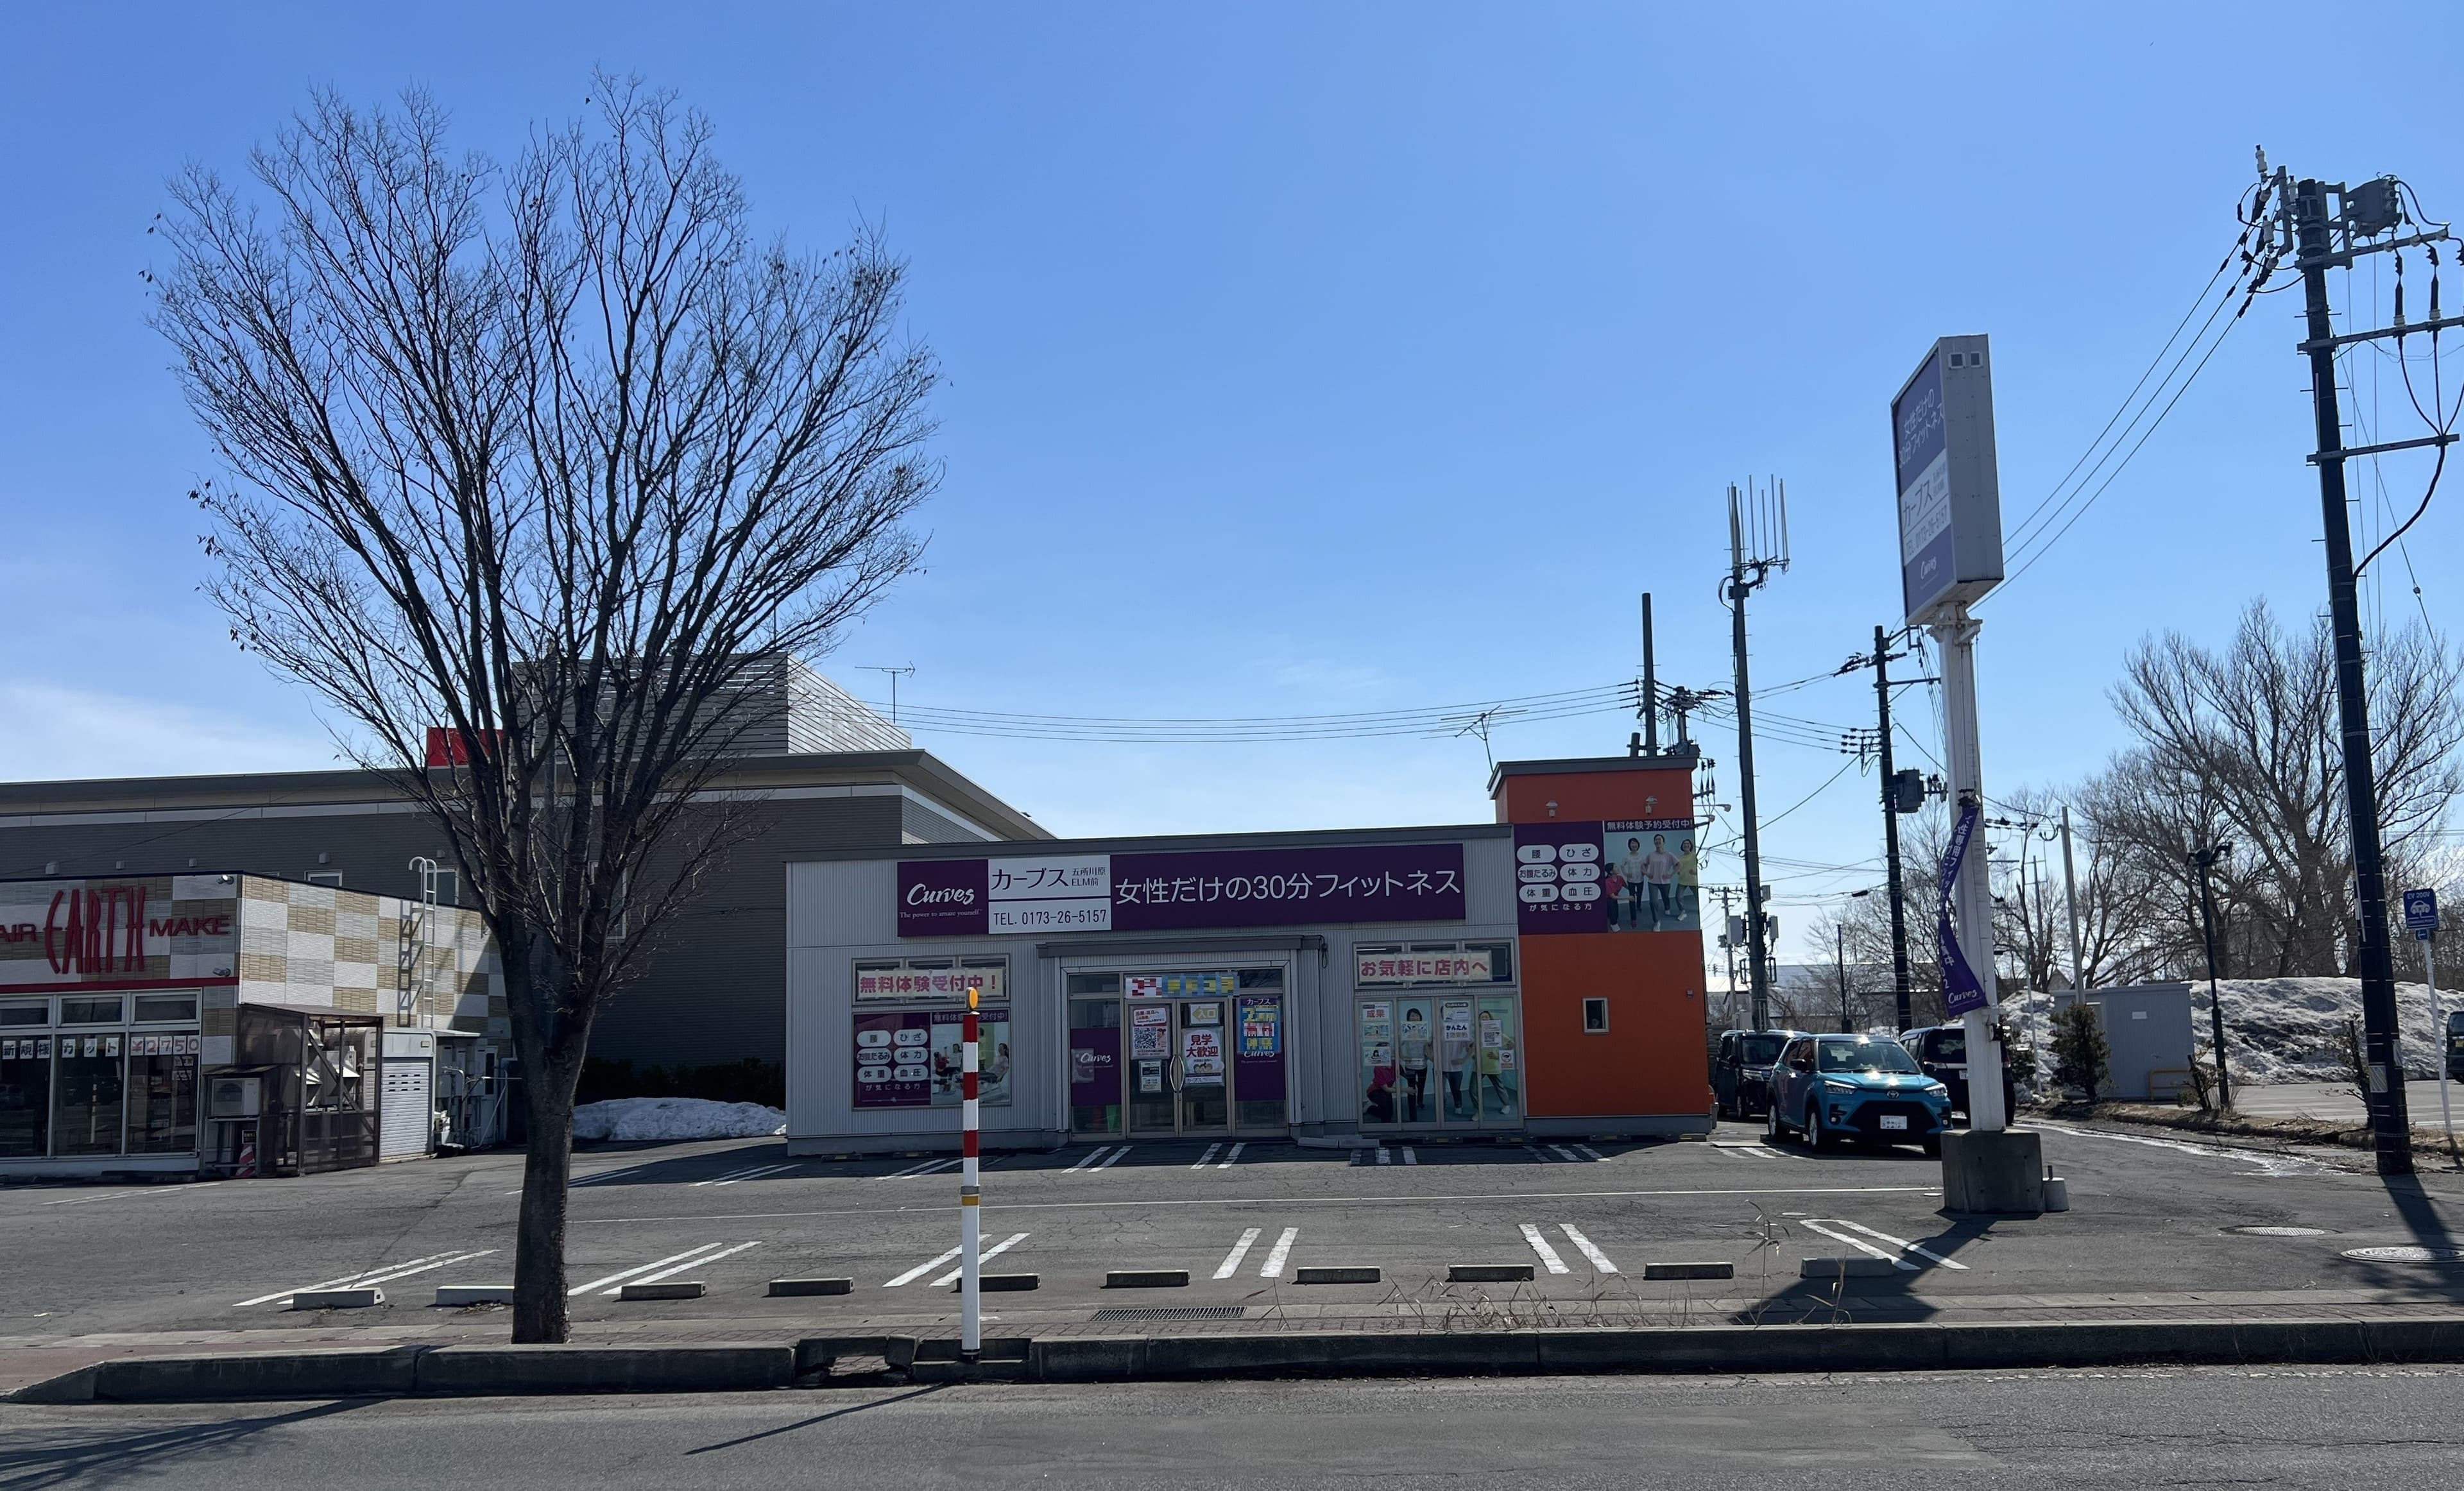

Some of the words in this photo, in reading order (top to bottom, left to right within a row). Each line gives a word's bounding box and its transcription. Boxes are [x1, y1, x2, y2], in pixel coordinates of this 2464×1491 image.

[1903, 479, 1933, 529] カーブス
[1566, 848, 1591, 857] ひざ
[1072, 867, 1106, 876] 五所川原
[1519, 868, 1556, 878] お腹たるみ
[1568, 867, 1592, 877] 体力
[991, 867, 1068, 890] カーブス
[1072, 878, 1099, 887] ELM前
[1115, 870, 1460, 905] 女性だけの30分フィットネス
[1527, 888, 1551, 898] 体重
[1568, 887, 1593, 896] 血圧
[906, 883, 975, 906] Curves
[1529, 903, 1592, 912] が気になる方
[994, 912, 1017, 925] TEL.
[1022, 910, 1107, 925] 0173-26-5157
[44, 886, 146, 974] EARTH
[150, 915, 231, 937] MAKE
[1361, 958, 1488, 976] お気軽に店内へ
[1948, 989, 1978, 1005] Curves
[1198, 1009, 1216, 1018] 入口
[900, 1032, 922, 1042] ひざ
[1191, 1034, 1213, 1046] 見学
[64, 1040, 117, 1054] カット
[131, 1037, 199, 1053] ¥2750
[900, 1050, 922, 1059] 体力
[1081, 1052, 1111, 1063] Curves
[1186, 1046, 1219, 1058] 大歓迎
